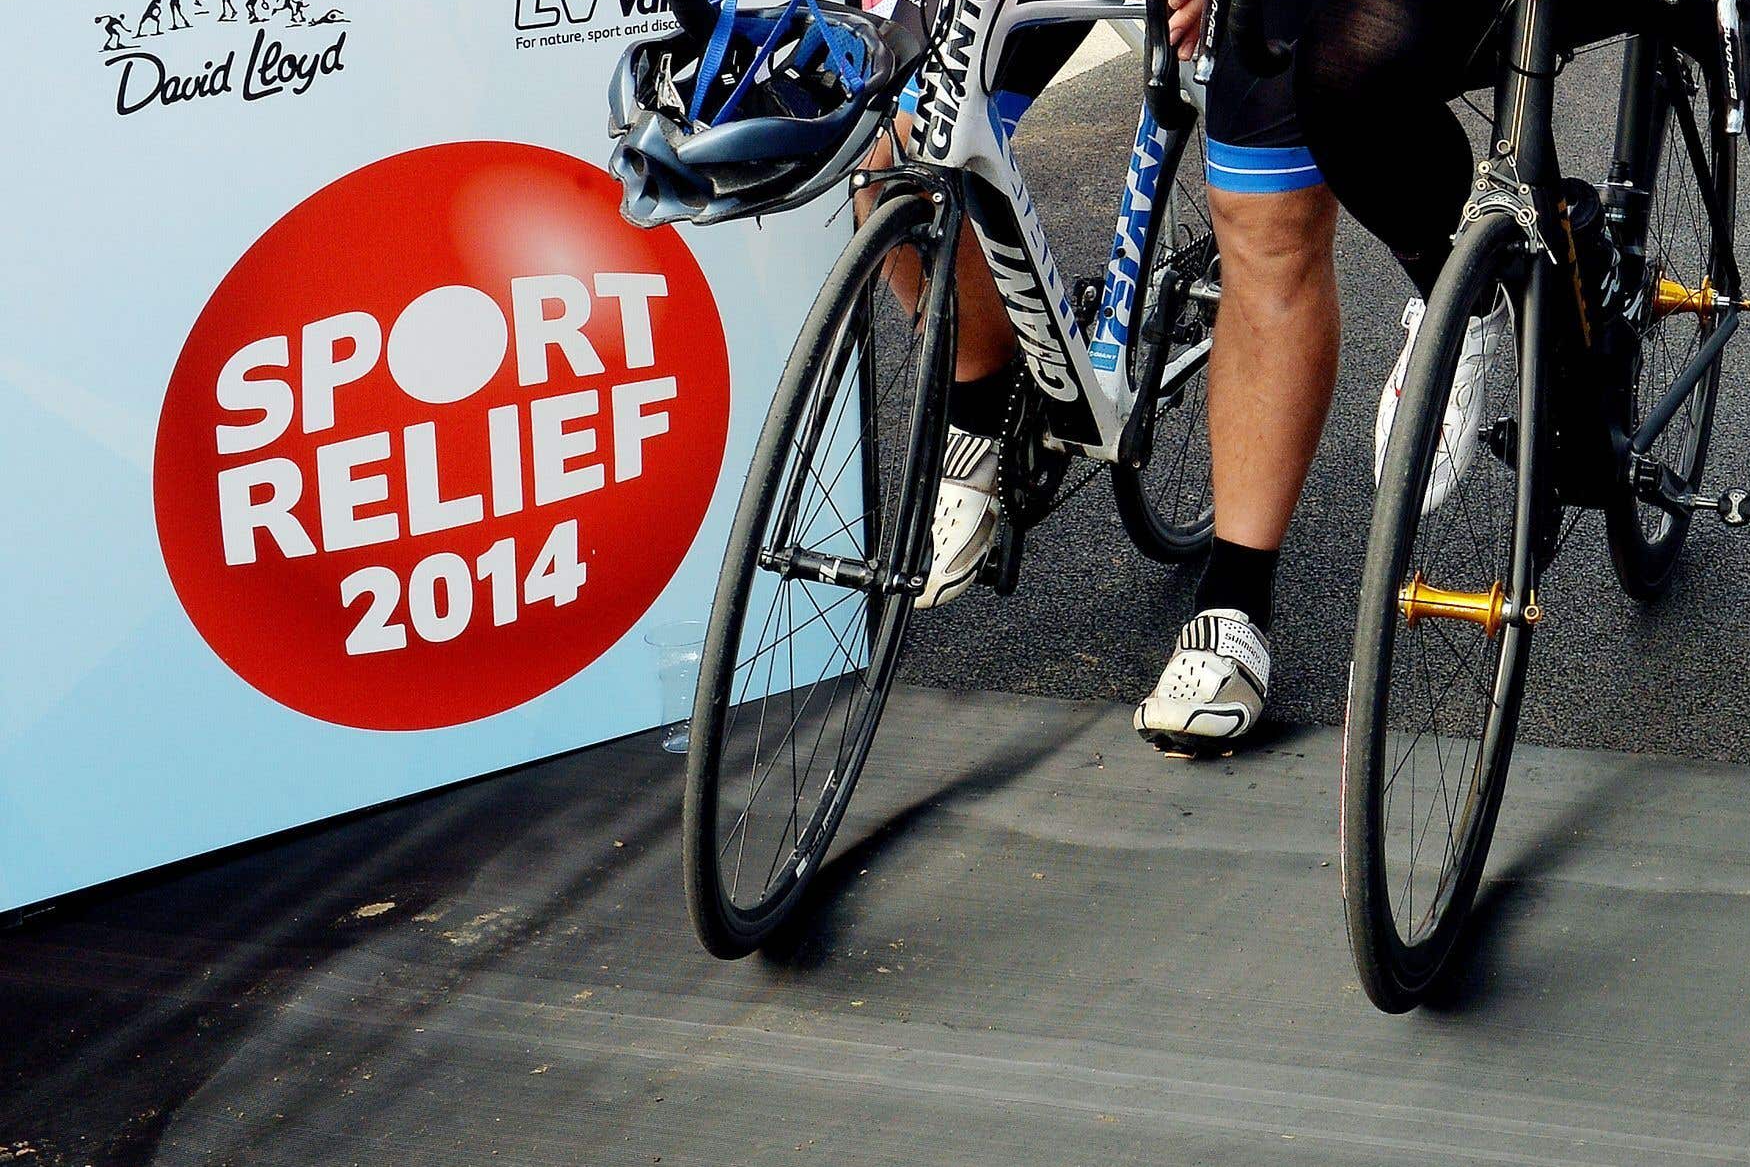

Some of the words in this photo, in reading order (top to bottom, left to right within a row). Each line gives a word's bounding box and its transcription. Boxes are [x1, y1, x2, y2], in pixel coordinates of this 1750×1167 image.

[105, 50, 235, 115] David
[243, 28, 347, 101] Lloyd
[515, 36, 537, 50] For
[540, 31, 585, 46] nature,
[587, 25, 621, 42] sport
[625, 21, 648, 36] and
[215, 273, 669, 455] SPORT
[970, 217, 1079, 403] GIANT
[217, 376, 678, 567] RELIEF
[341, 519, 588, 656] 2014
